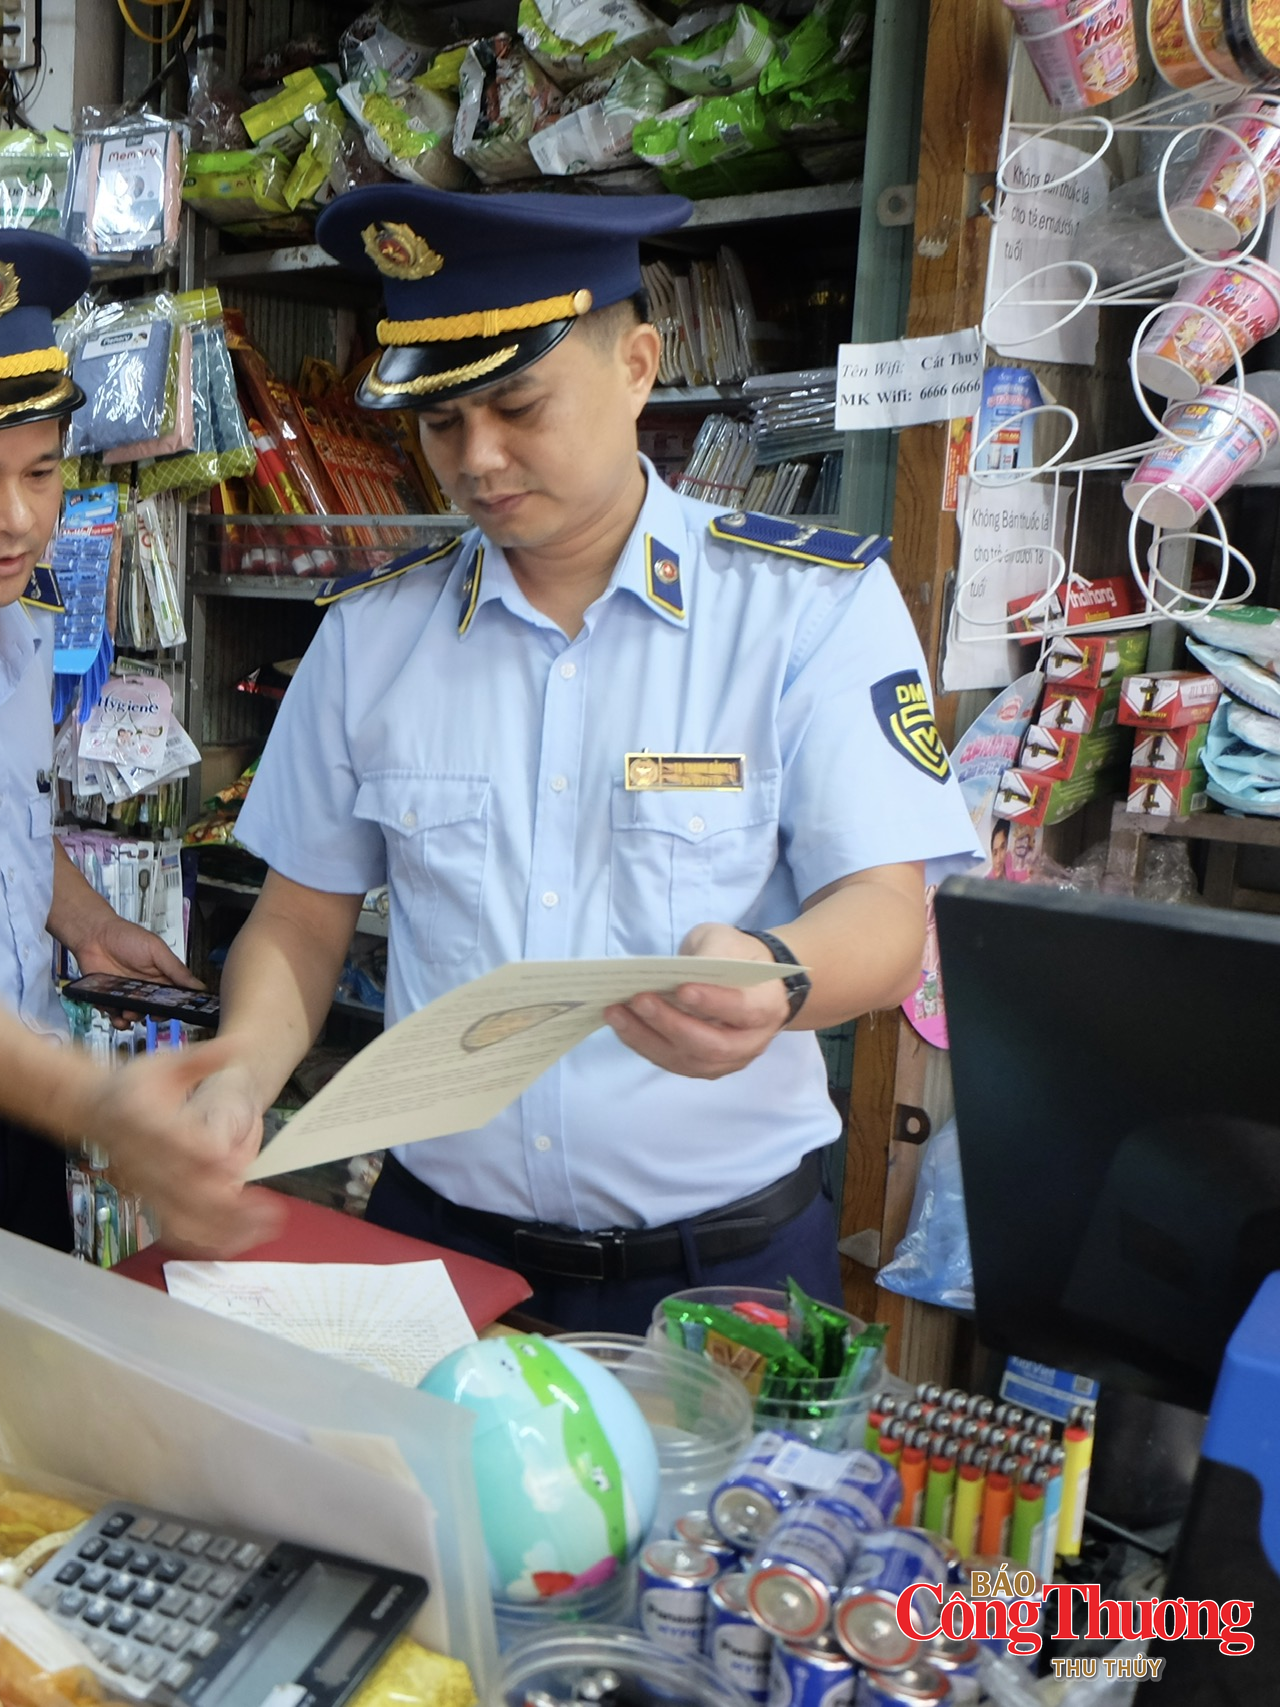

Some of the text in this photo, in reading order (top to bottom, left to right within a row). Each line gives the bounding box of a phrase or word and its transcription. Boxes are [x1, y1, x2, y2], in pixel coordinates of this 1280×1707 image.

[841, 364, 868, 378] Tên
[874, 359, 905, 379] Wifi:
[921, 355, 944, 371] Cát
[840, 392, 870, 406] MK
[877, 389, 912, 404] Wifi:
[920, 384, 948, 400] 6666
[951, 378, 981, 395] 6666
[972, 508, 1000, 532] Không
[1002, 510, 1019, 529] Bán
[1041, 512, 1049, 532] lá
[974, 546, 989, 563] cho
[970, 577, 987, 598] tuổi
[98, 696, 159, 715] Hygiene
